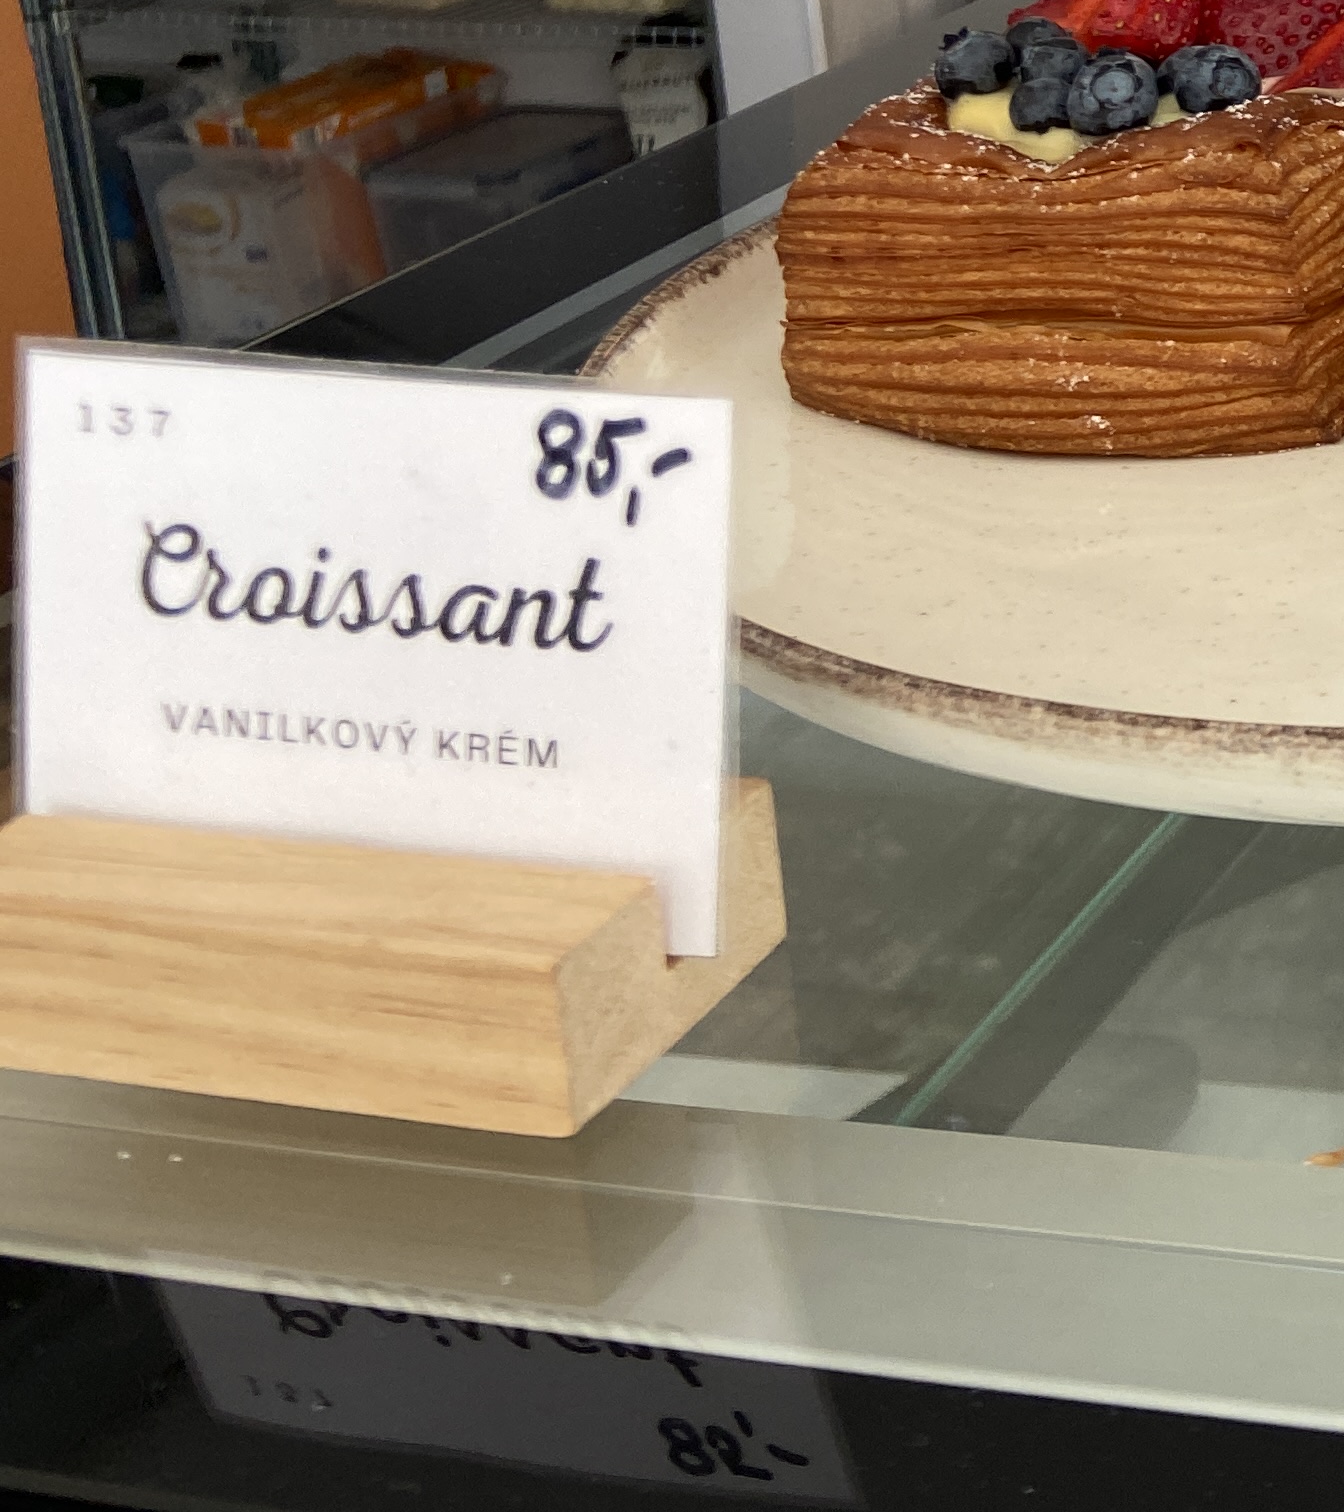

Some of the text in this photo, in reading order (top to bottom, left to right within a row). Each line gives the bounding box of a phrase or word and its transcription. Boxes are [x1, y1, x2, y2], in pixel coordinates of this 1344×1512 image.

[140, 522, 613, 653] Croissant
[160, 700, 560, 770] VANILKOVÝ KRÉM
